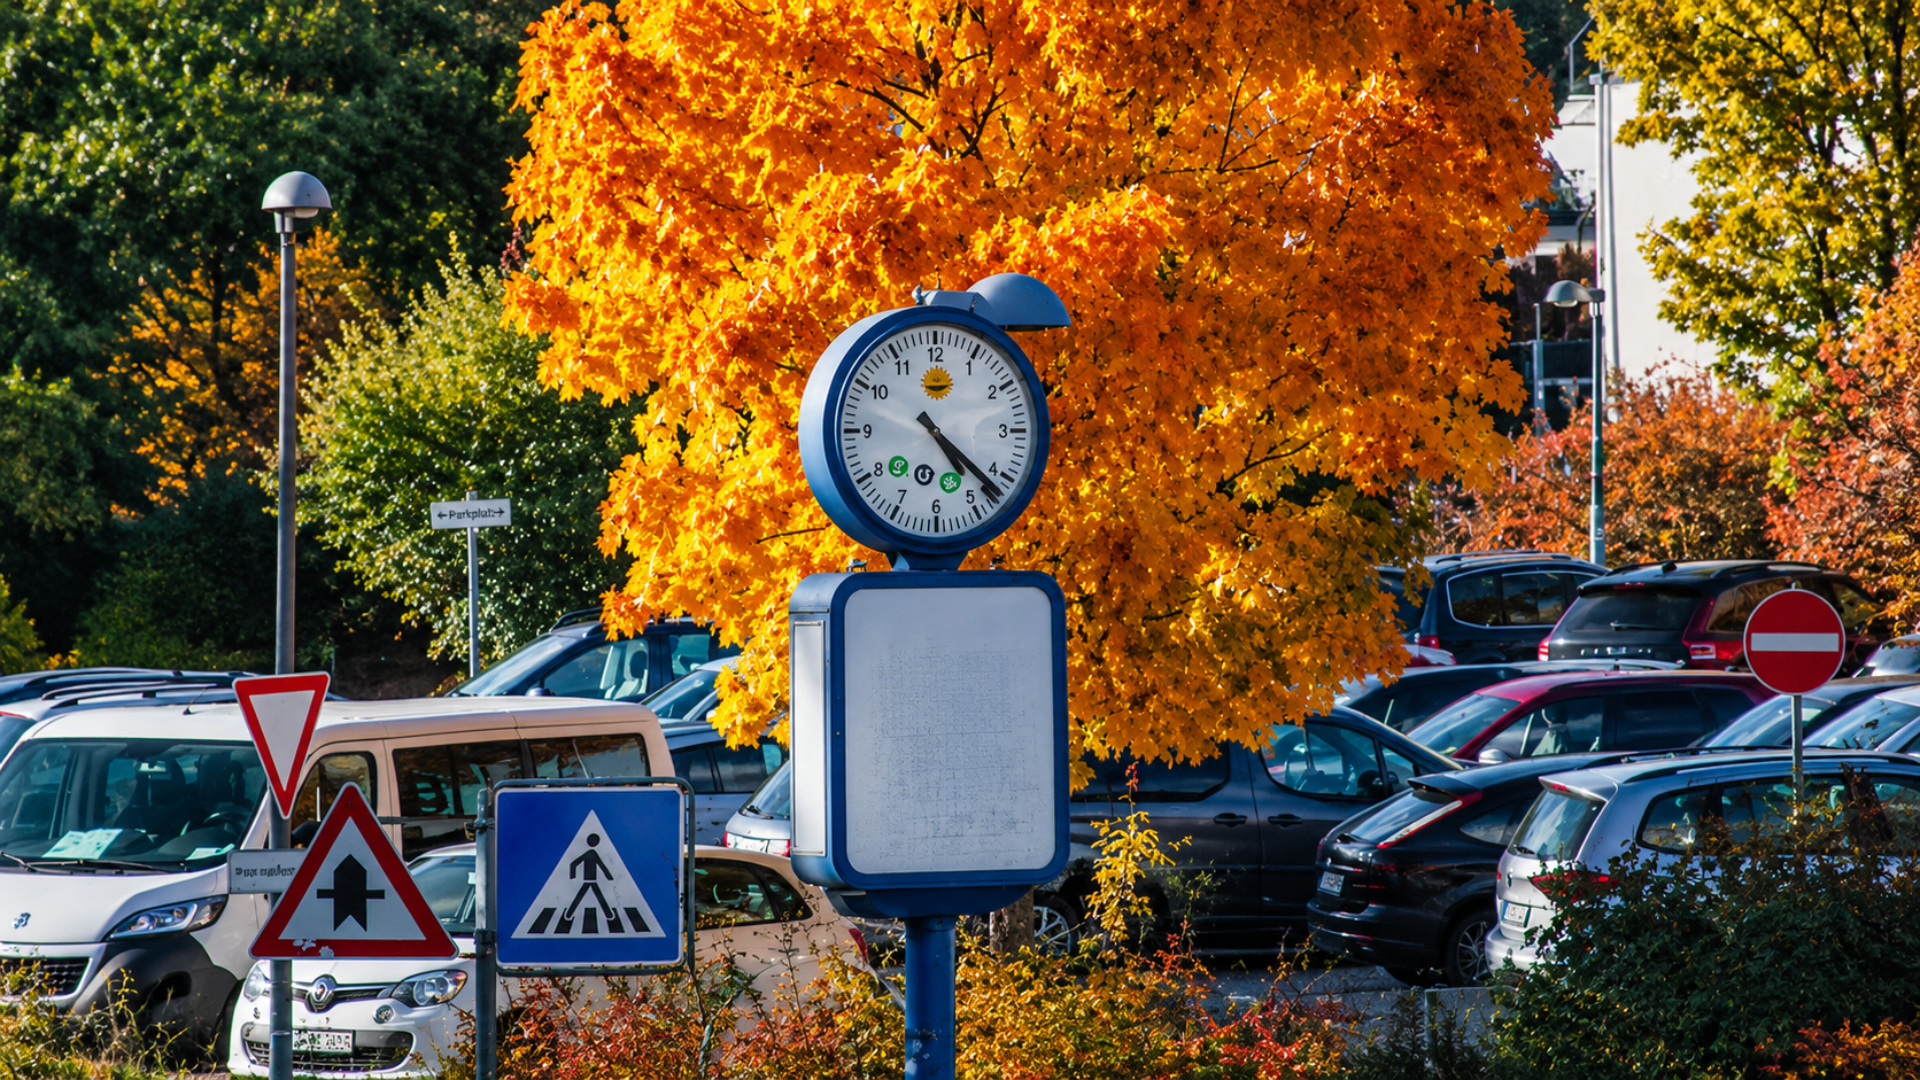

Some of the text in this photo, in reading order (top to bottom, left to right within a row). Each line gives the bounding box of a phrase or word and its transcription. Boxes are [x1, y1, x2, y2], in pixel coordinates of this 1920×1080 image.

[927, 347, 944, 363] 12
[894, 360, 910, 376] 11
[965, 360, 973, 376] 1
[871, 384, 889, 400] 10
[988, 385, 997, 400] 2
[862, 424, 872, 439] 9
[998, 424, 1008, 439] 3
[873, 462, 884, 477] 8
[988, 462, 998, 477] 4
[897, 489, 907, 504] 7
[966, 489, 975, 504] 5
[931, 499, 941, 514] 6
